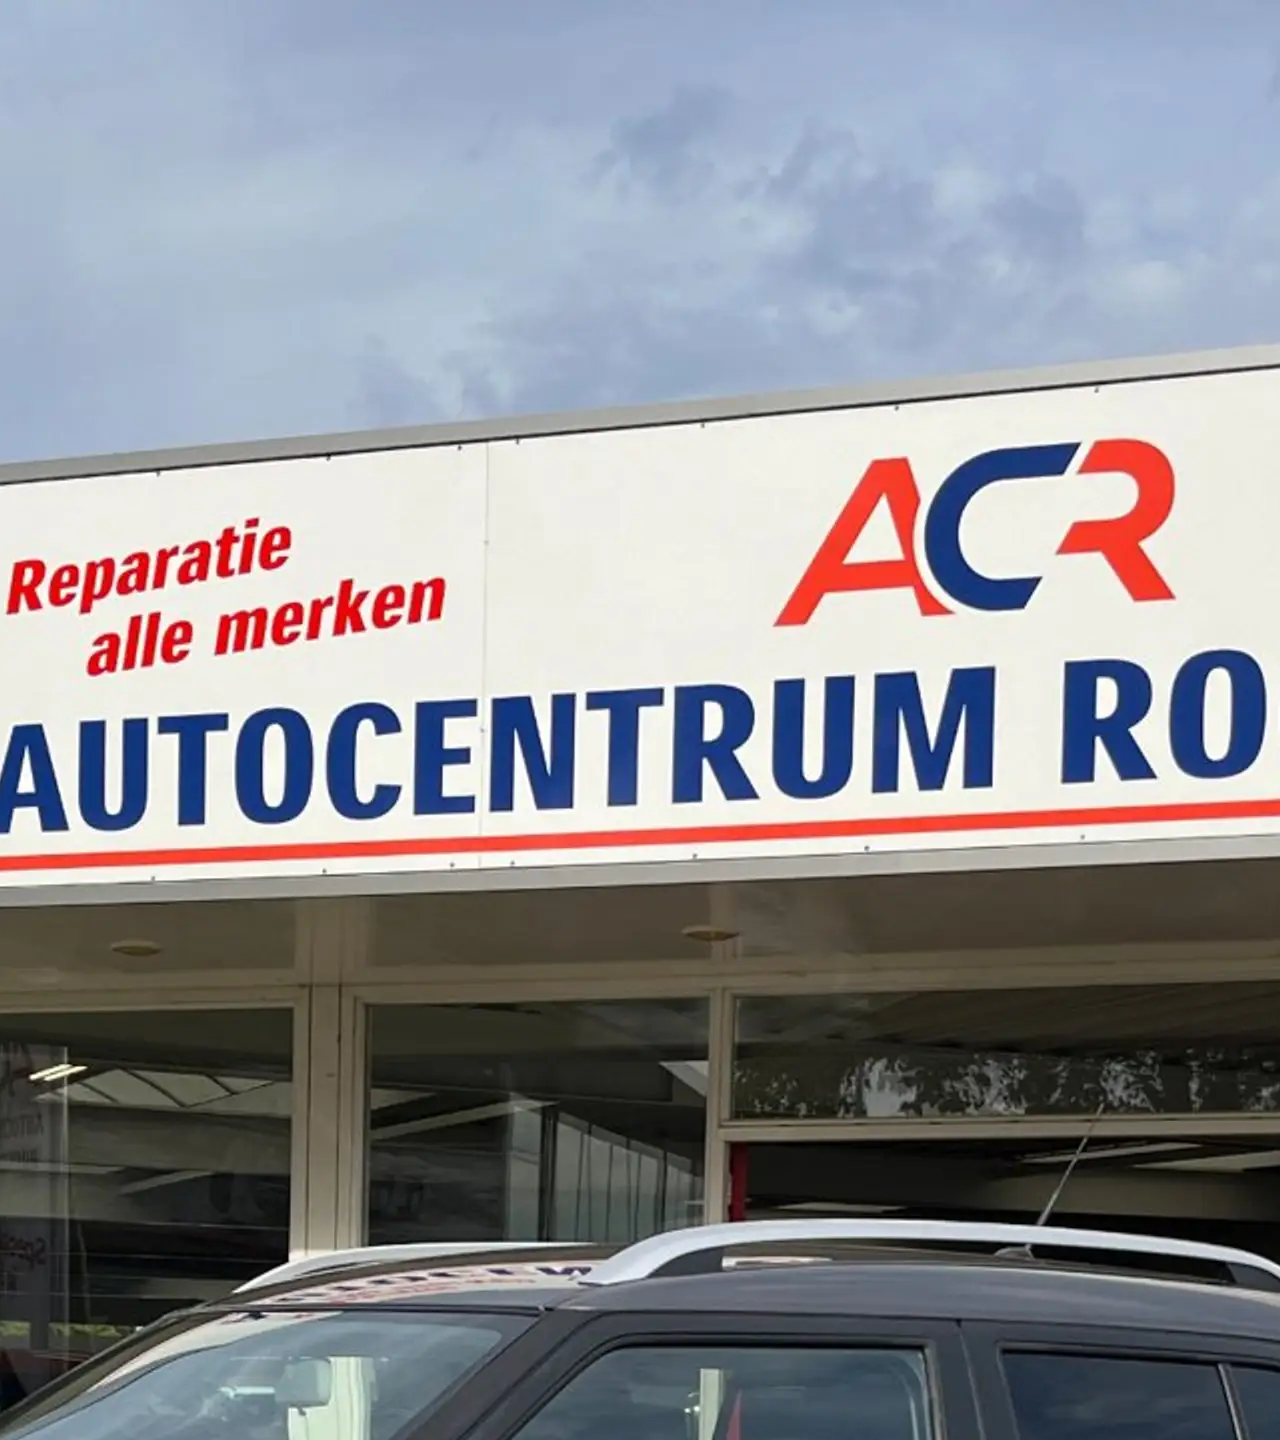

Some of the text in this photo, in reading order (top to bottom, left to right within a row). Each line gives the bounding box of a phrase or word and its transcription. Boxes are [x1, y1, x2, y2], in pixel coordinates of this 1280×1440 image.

[6, 517, 293, 616] Reparatie
[776, 437, 1176, 627] ACR
[86, 575, 448, 677] alle merken
